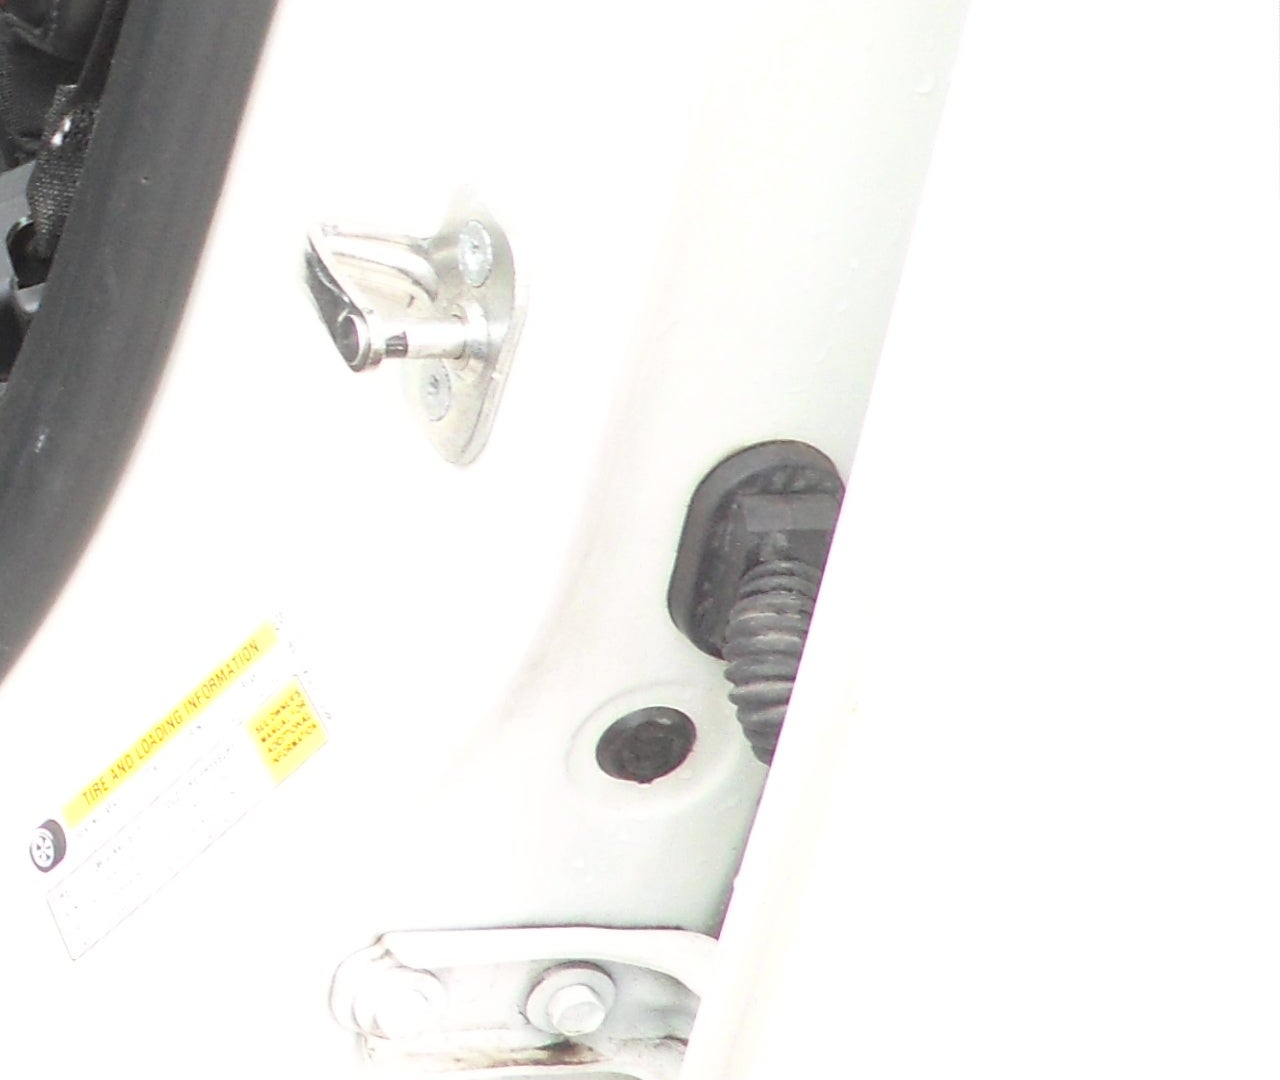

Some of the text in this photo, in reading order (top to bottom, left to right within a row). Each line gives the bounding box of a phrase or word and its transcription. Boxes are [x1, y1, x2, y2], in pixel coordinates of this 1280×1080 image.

[82, 776, 109, 805] TIRE
[110, 753, 135, 780] AND
[135, 709, 183, 760] LOADING
[183, 639, 260, 715] INFORMATION
